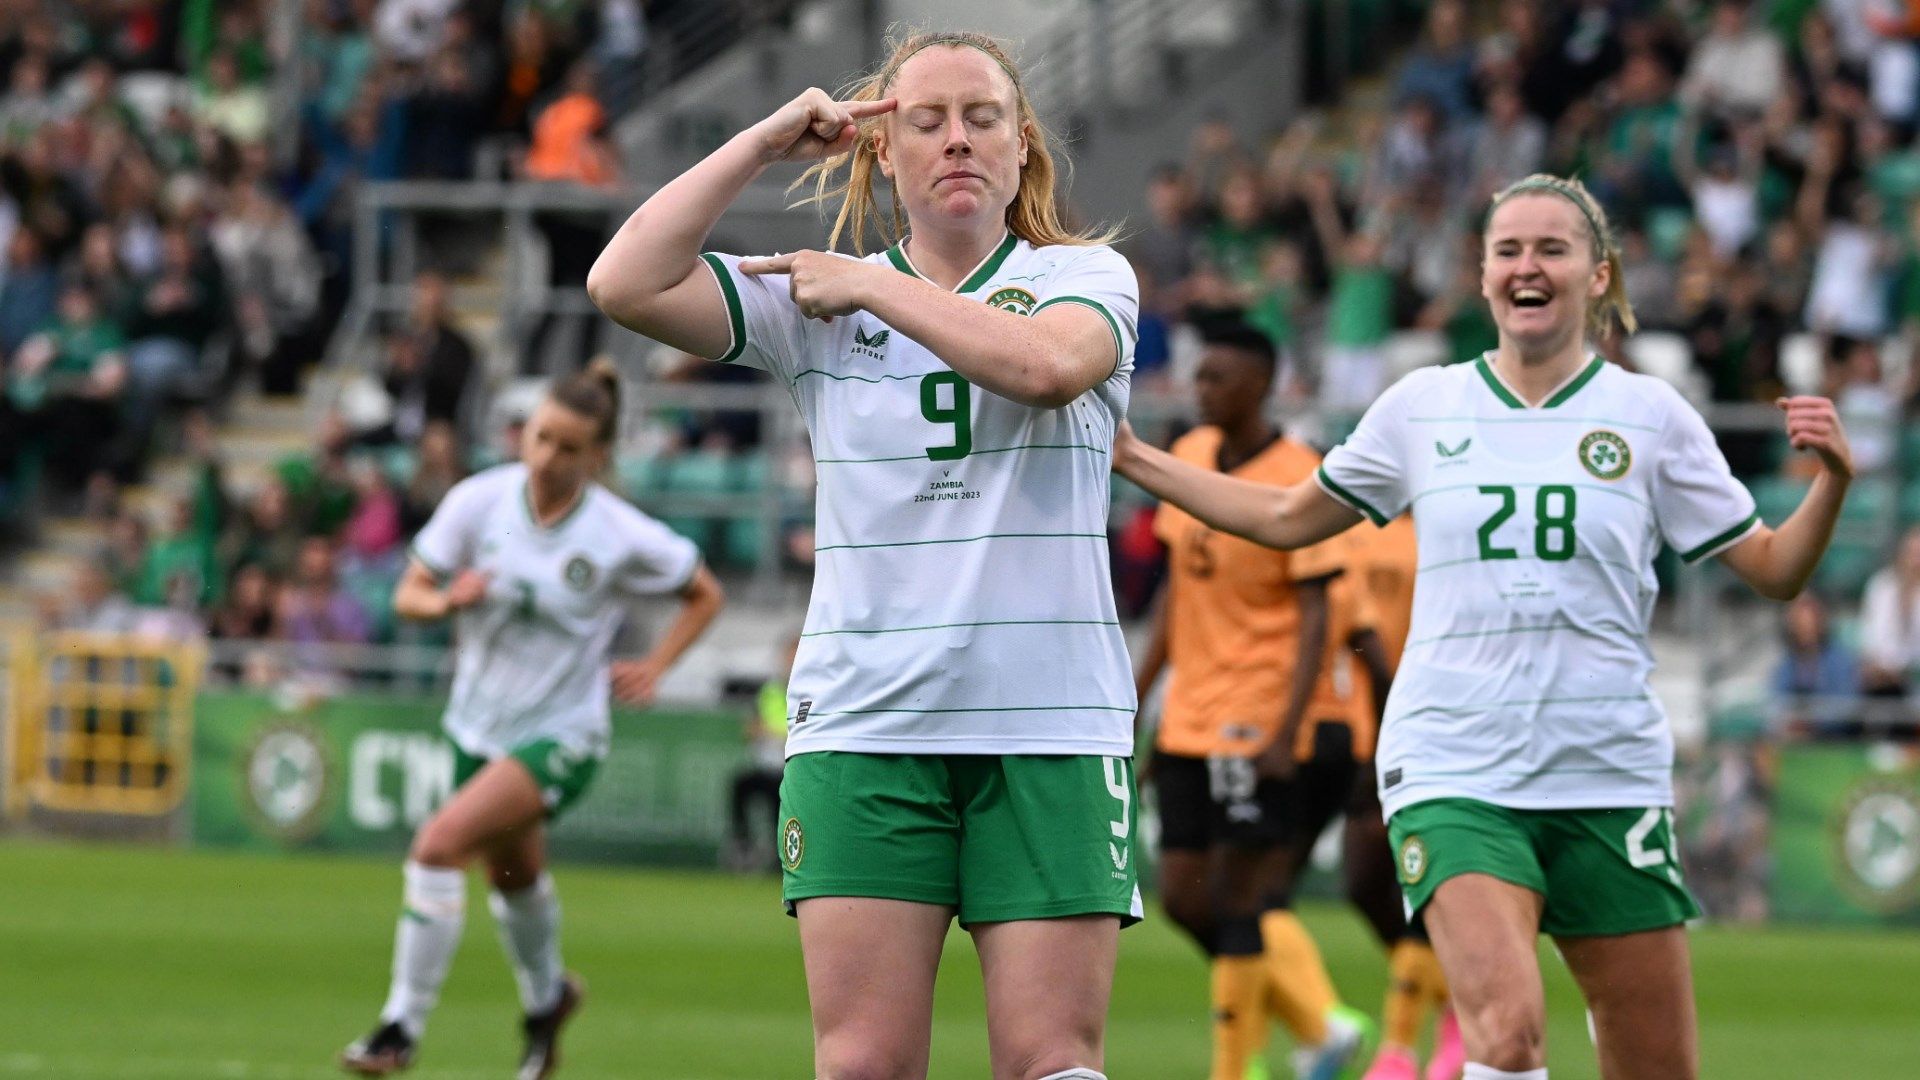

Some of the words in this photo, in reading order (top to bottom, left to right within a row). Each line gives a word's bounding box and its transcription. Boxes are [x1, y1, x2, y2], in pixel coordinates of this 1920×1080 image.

[989, 291, 1036, 307] RELAND
[850, 347, 885, 361] ASTORE
[920, 371, 971, 461] 9
[930, 481, 964, 490] ZAMBIA
[914, 494, 935, 502] 22nd
[937, 492, 959, 501] JUNE
[961, 491, 981, 500] 2023
[1477, 485, 1576, 562] 28
[1102, 756, 1131, 839] 9
